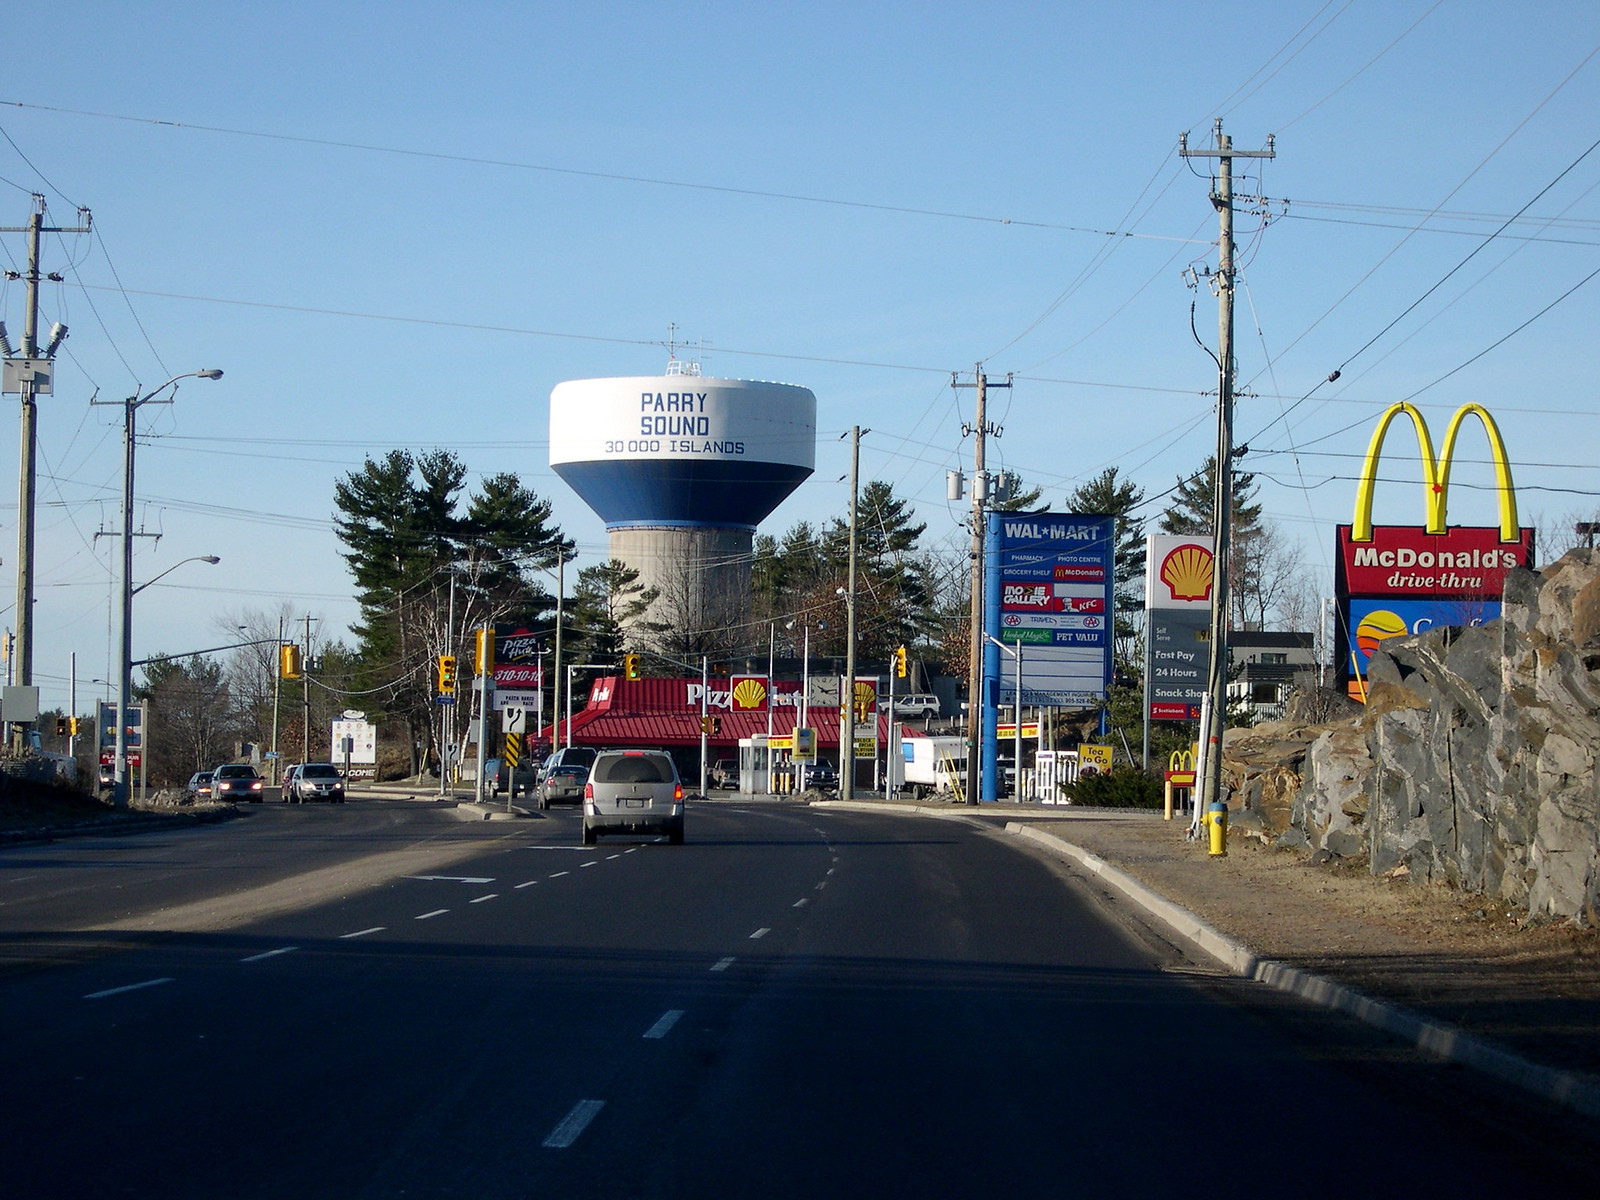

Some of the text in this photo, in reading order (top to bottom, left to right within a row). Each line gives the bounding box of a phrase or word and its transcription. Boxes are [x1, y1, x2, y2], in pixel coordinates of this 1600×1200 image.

[641, 393, 707, 412] PARRY
[641, 416, 709, 436] SOUND
[670, 440, 745, 454] ISLANDS
[1354, 547, 1517, 569] McDonald's
[1387, 571, 1482, 588] drive-thru
[1003, 595, 1050, 607] GALLERY
[1079, 599, 1097, 611] KFC
[1056, 633, 1099, 642] PET VALU
[503, 638, 536, 654] Pizza
[1155, 650, 1195, 662] Fast Pay
[1155, 668, 1198, 678] 24 Hours
[687, 683, 732, 708] Pizz
[1155, 688, 1203, 698] Snack Sho
[1088, 747, 1104, 756] Tea
[1083, 755, 1108, 765] to Go
